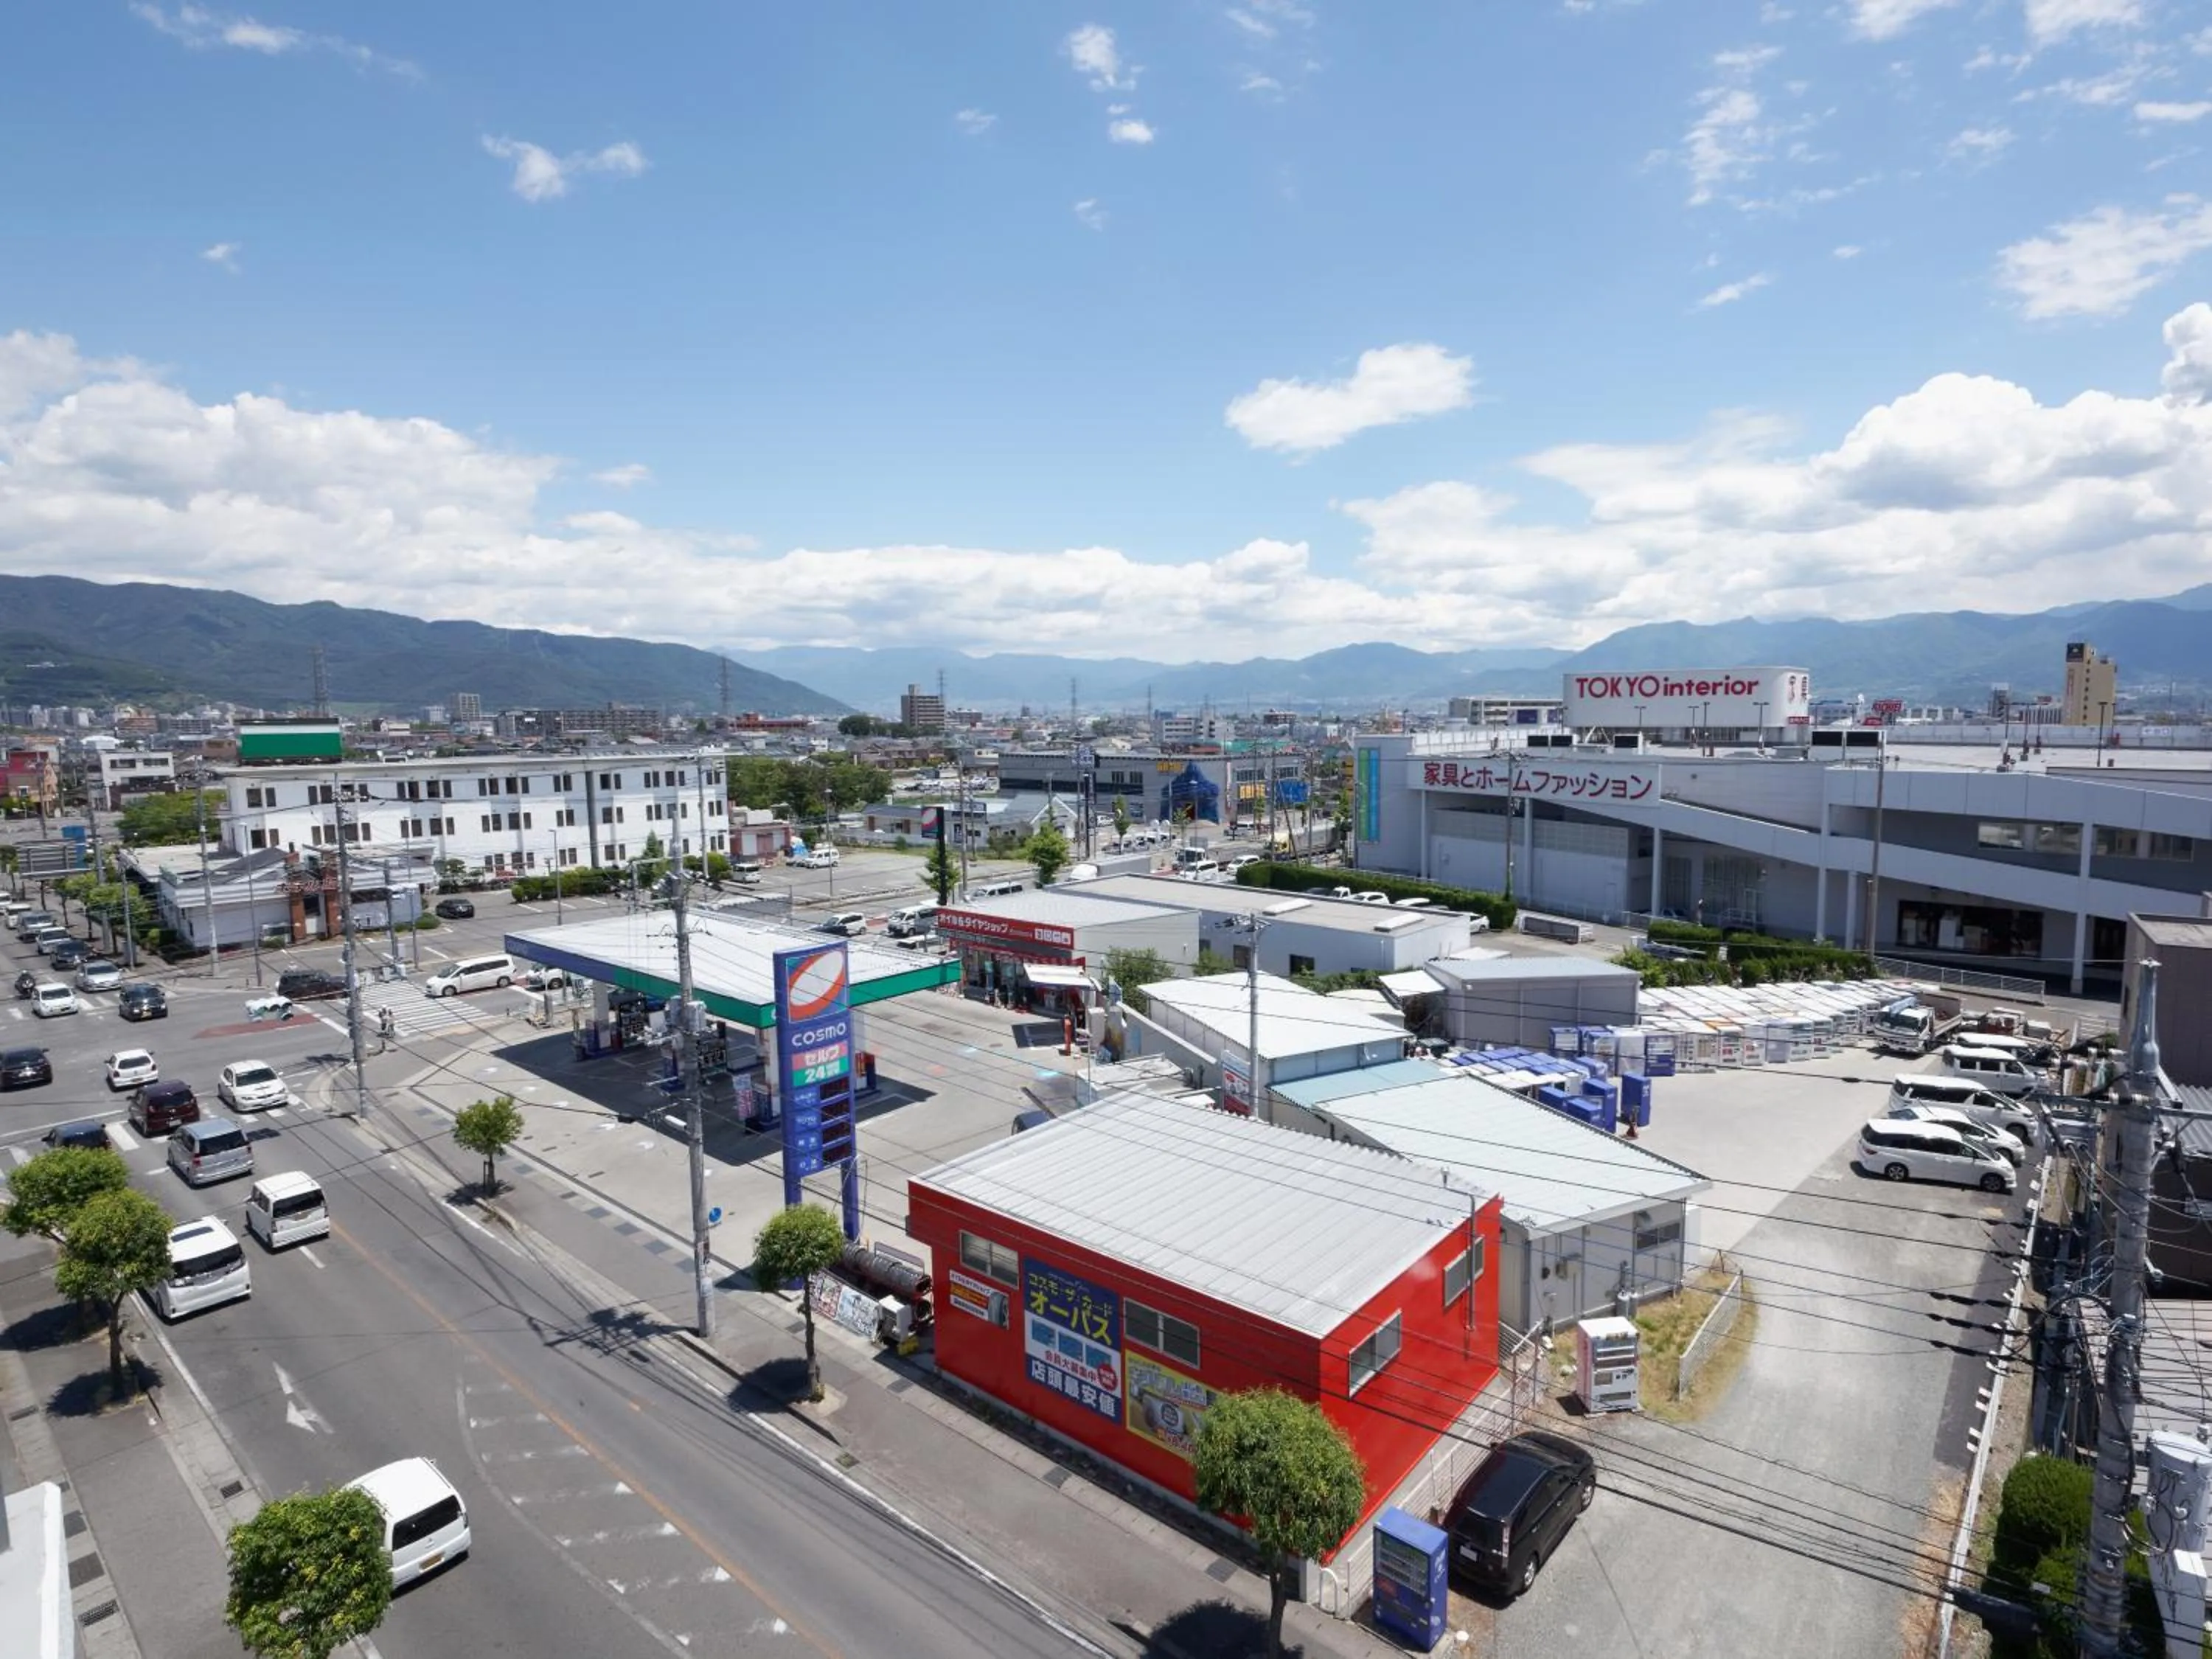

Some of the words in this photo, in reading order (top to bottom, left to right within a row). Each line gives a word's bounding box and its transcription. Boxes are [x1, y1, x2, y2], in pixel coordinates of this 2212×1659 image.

[1576, 675, 1660, 698] TOKYO
[1663, 675, 1759, 697] interior
[1424, 762, 1652, 800] 家具とホームファッション
[804, 1044, 840, 1067] セルフ
[1029, 1291, 1112, 1346] オーパス
[1032, 1359, 1116, 1417] 店頭最安値
